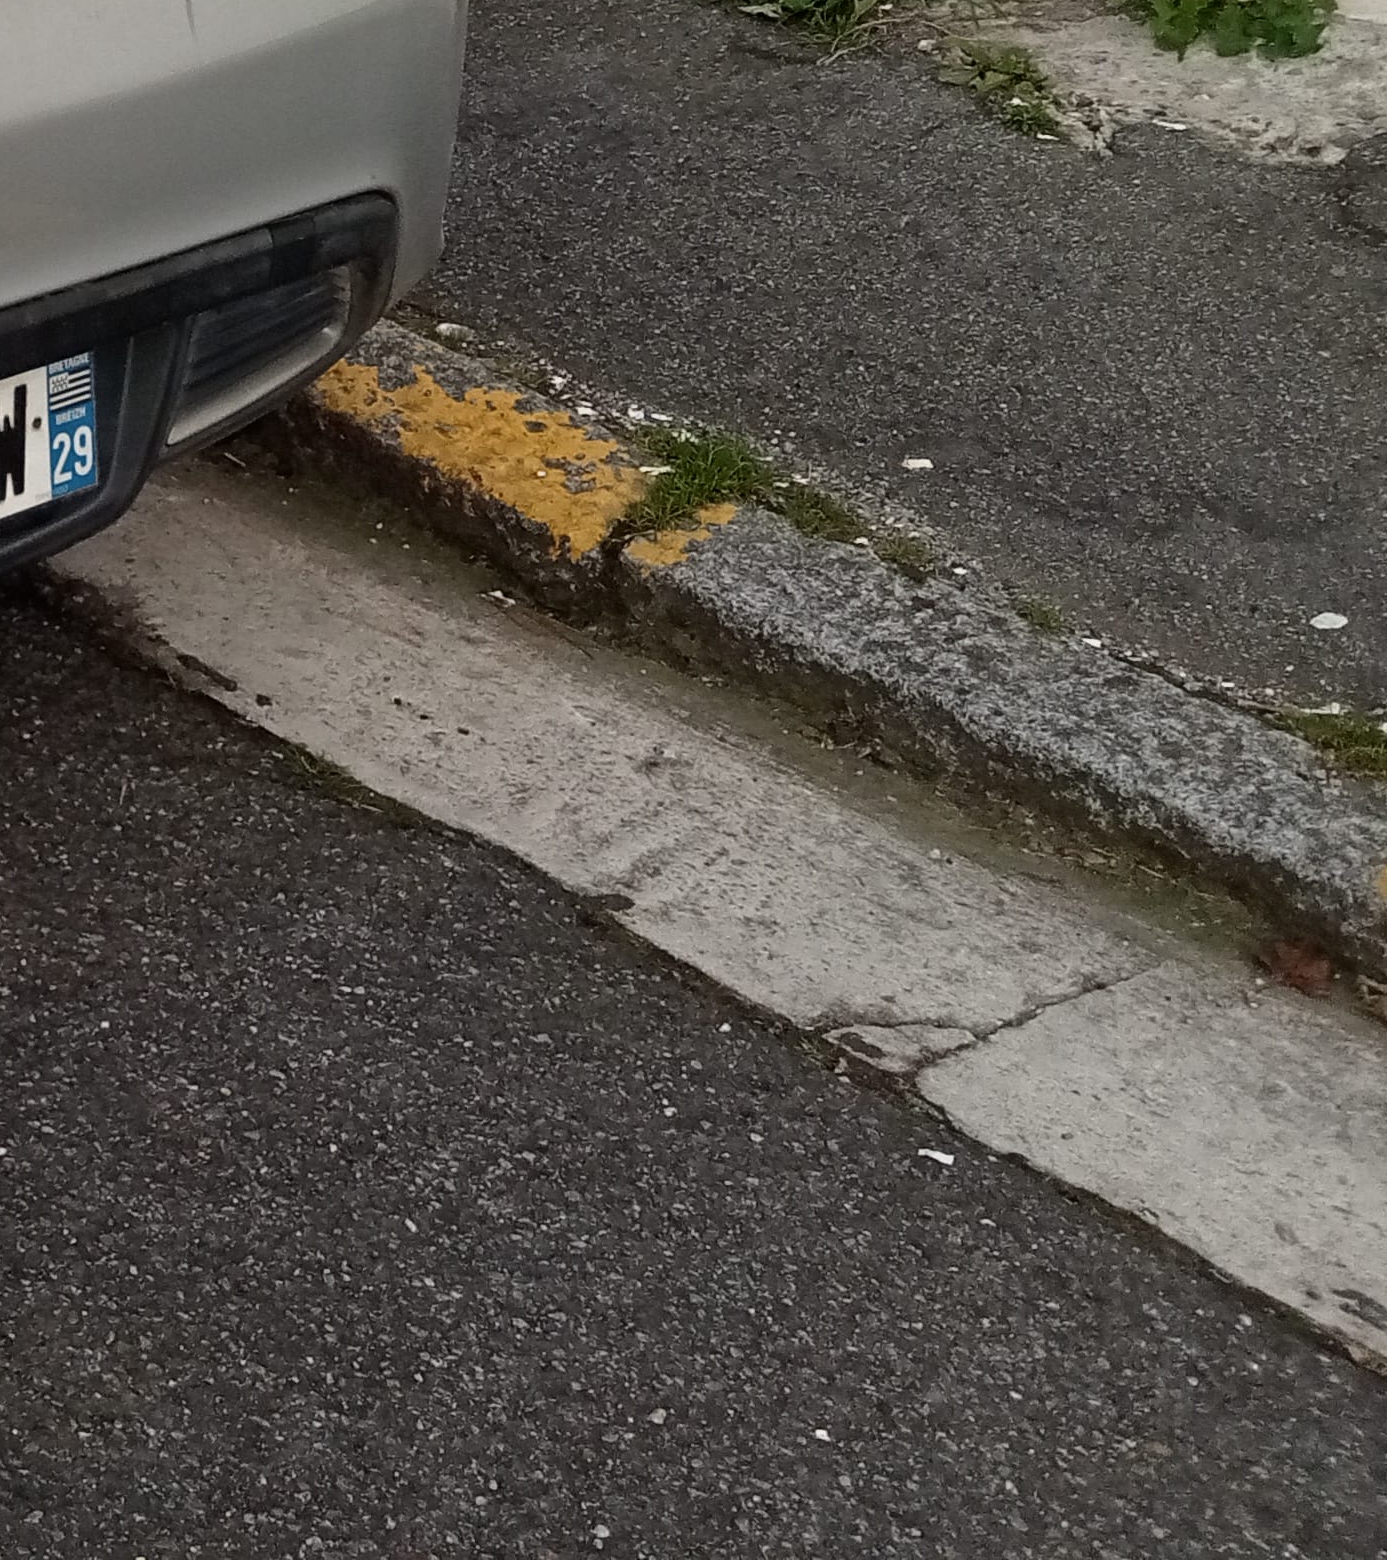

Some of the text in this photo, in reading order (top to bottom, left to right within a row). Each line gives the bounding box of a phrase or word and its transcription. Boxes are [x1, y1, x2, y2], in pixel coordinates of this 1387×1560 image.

[48, 351, 90, 376] BRETAGNE
[55, 406, 87, 426] BREIZH
[52, 425, 94, 486] 29
